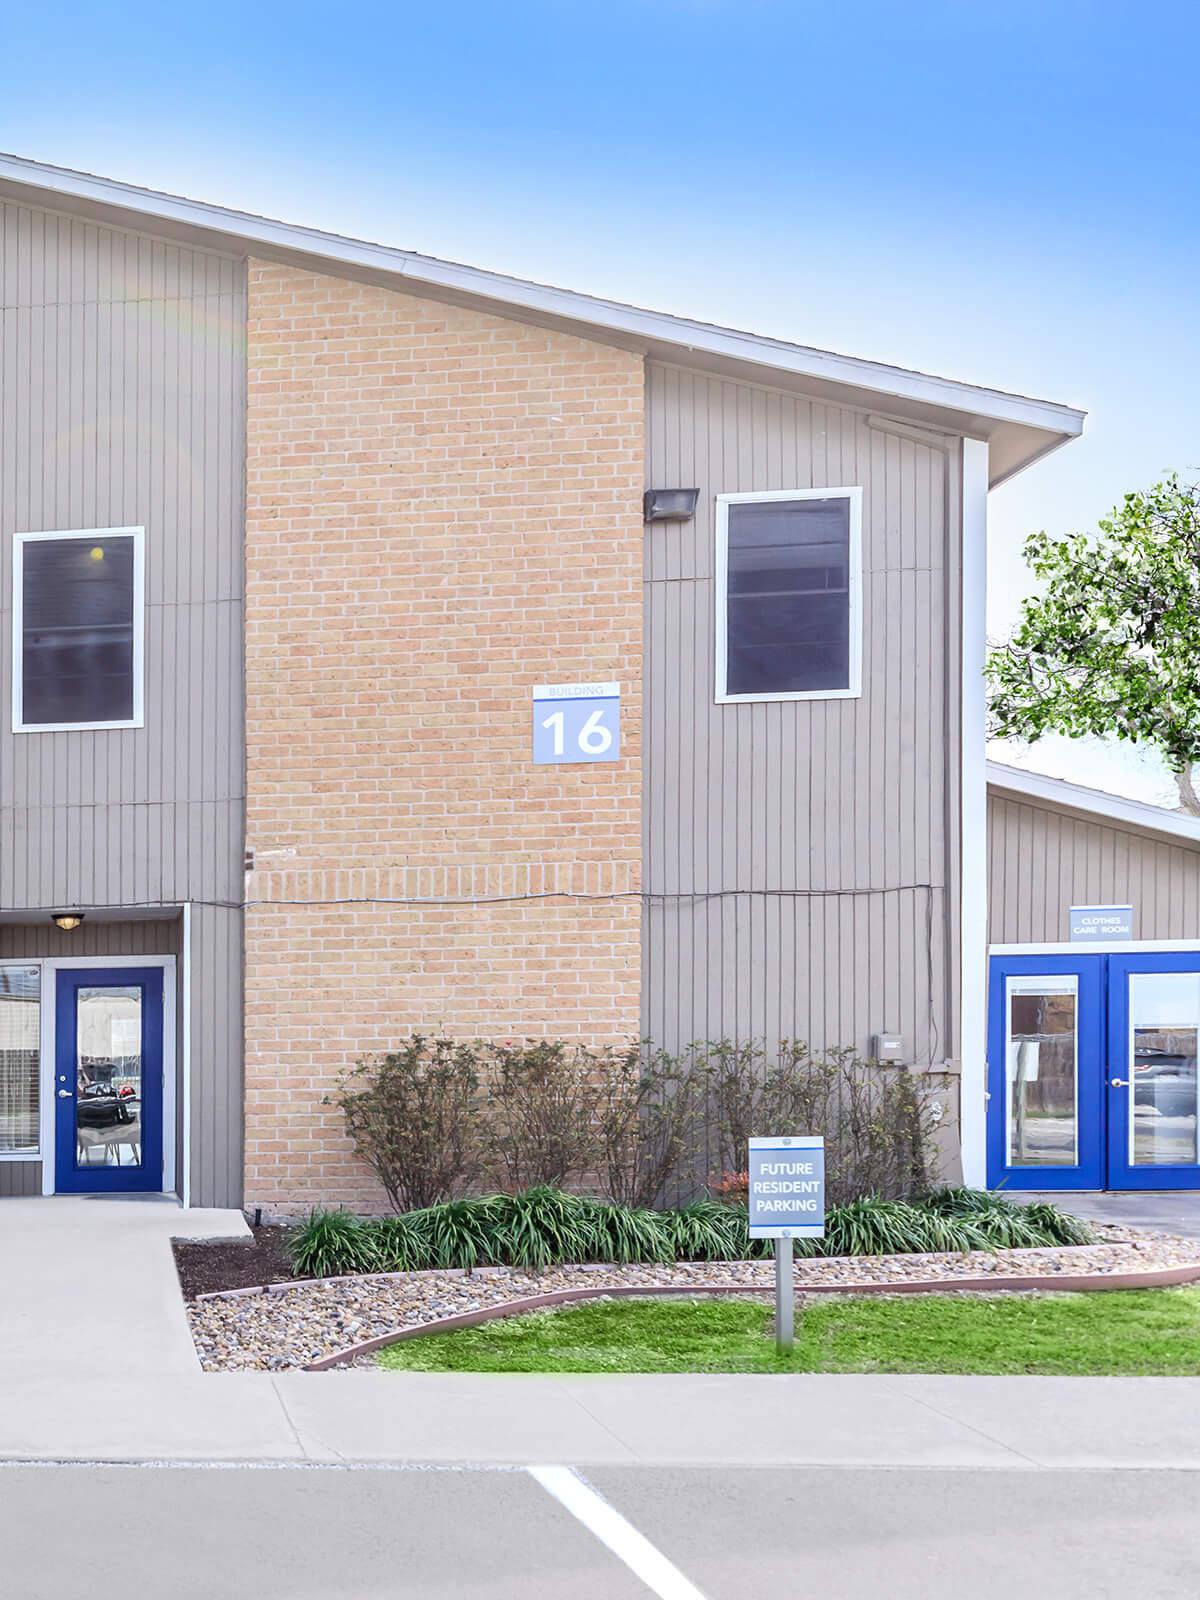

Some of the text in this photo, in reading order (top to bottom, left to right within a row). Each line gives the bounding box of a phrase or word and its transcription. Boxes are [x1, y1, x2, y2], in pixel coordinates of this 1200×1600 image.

[549, 686, 604, 697] BUILDING
[541, 710, 612, 756] 16
[1081, 916, 1121, 925] CLOTHES
[1073, 926, 1129, 934] CARE ROOM
[760, 1162, 814, 1175] FUTURE
[753, 1181, 820, 1194] RESIDENT
[756, 1199, 817, 1212] PARKING
